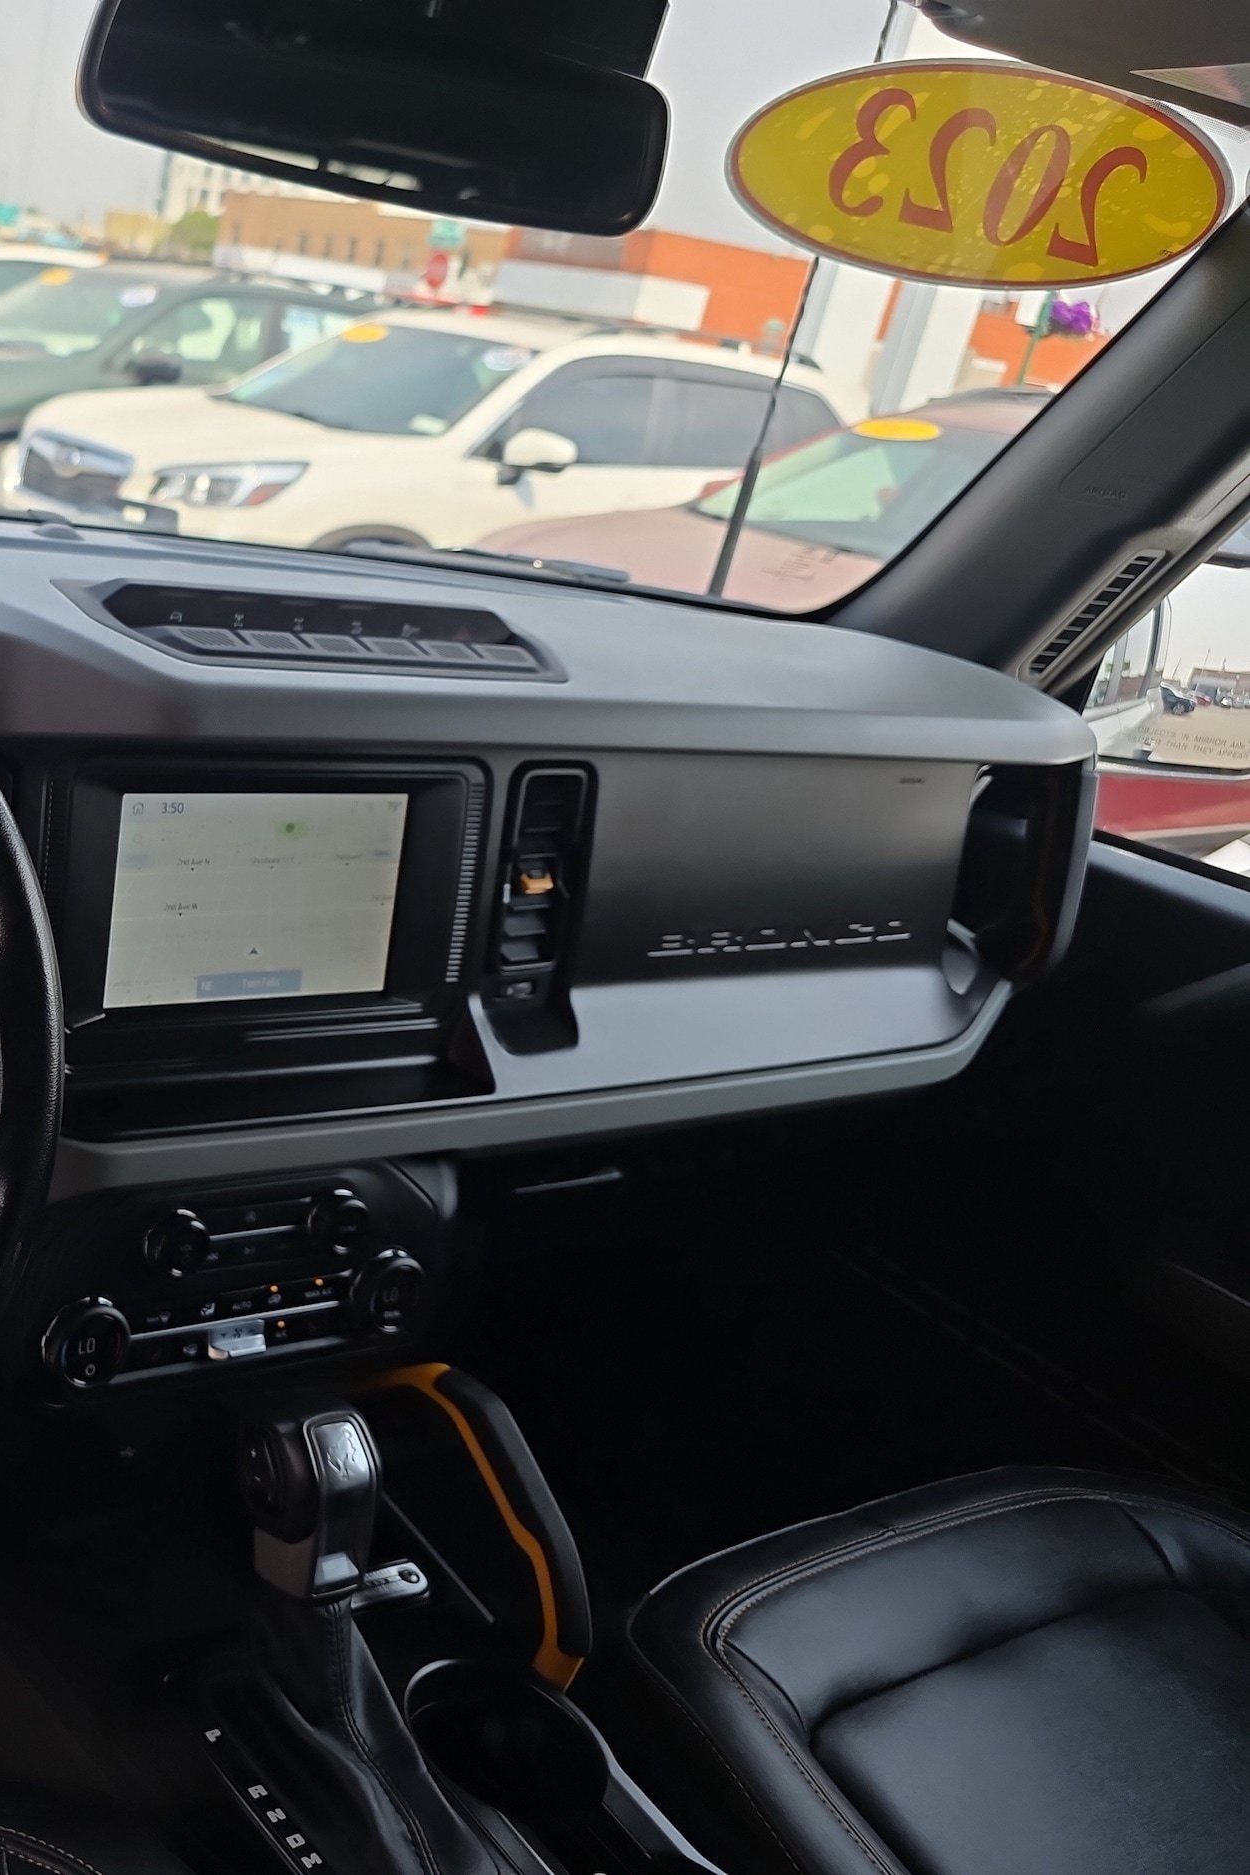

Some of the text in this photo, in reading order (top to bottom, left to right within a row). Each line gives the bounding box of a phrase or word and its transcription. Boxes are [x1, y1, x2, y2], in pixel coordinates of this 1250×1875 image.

[161, 802, 185, 815] 3:50
[78, 1337, 96, 1355] LO
[204, 1727, 222, 1743] P
[247, 1784, 269, 1800] R
[265, 1807, 287, 1824] N
[285, 1832, 306, 1849] D
[300, 1851, 323, 1870] M
